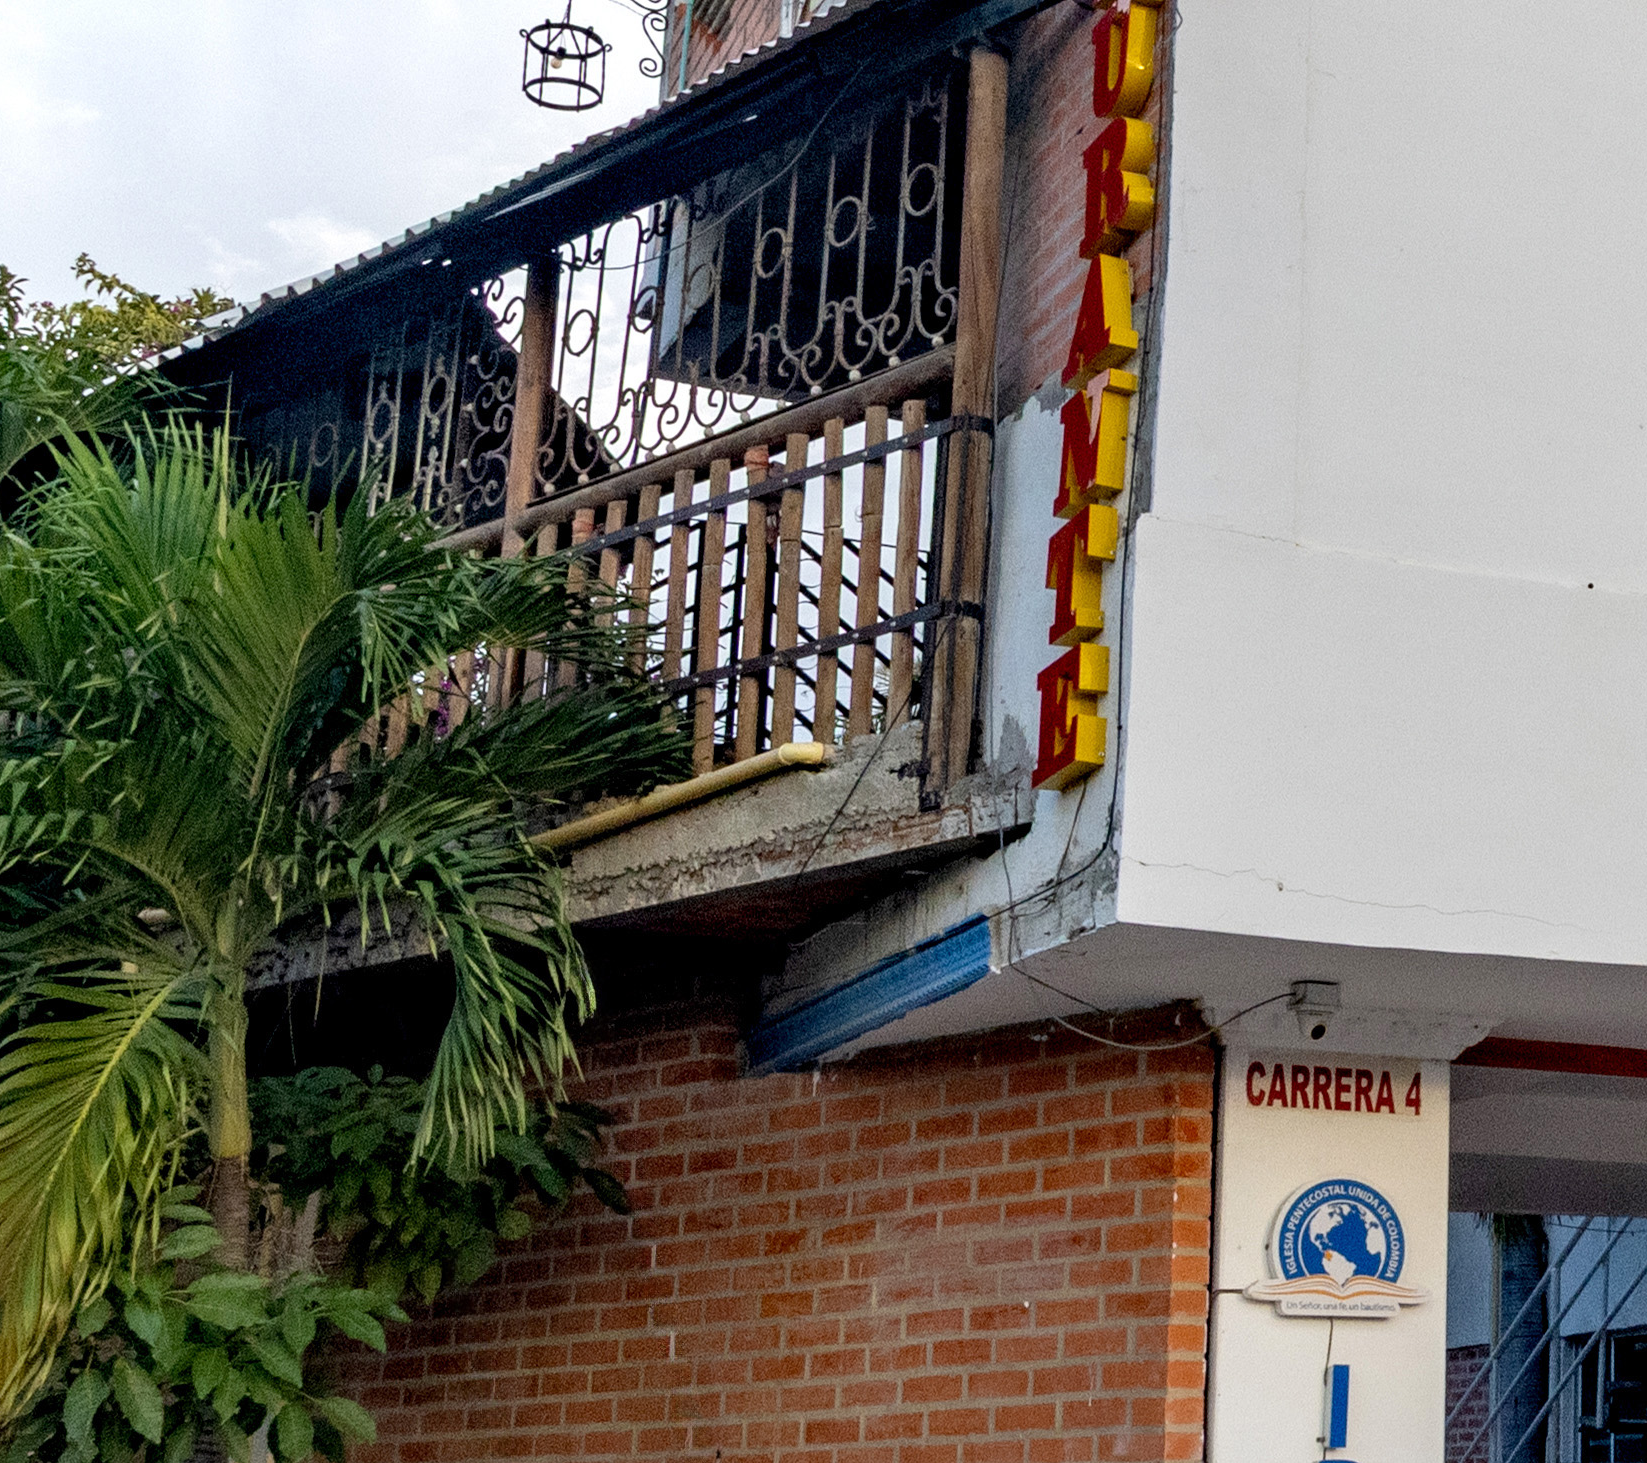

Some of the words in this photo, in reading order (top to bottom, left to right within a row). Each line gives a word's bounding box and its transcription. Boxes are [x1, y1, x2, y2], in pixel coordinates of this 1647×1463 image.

[1246, 1061, 1396, 1114] CARRERA
[1405, 1072, 1422, 1116] 4
[1287, 1184, 1347, 1230] PENTECOSTAL
[1348, 1185, 1380, 1209] UNIDA
[1376, 1204, 1392, 1221] DE
[1283, 1231, 1298, 1275] IGLESIA
[1384, 1219, 1401, 1278] COLOMBIA
[1286, 1301, 1298, 1309] Un
